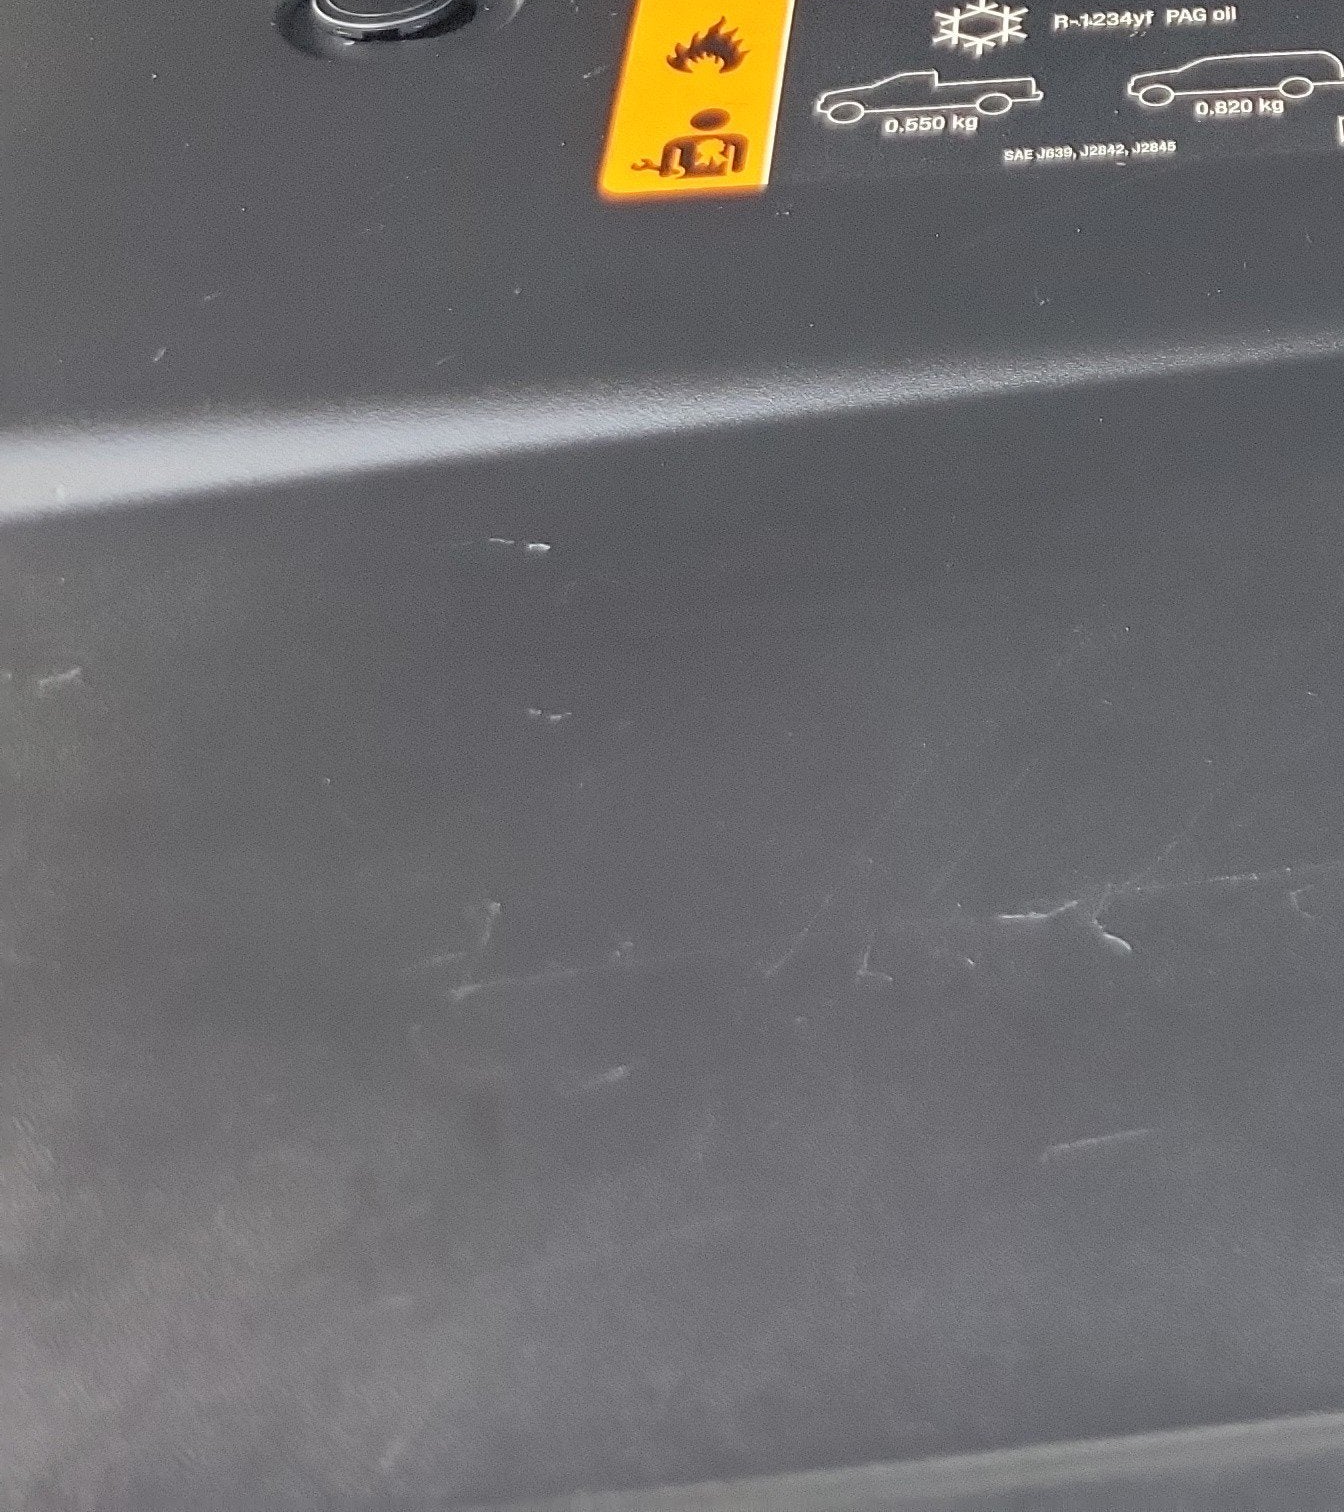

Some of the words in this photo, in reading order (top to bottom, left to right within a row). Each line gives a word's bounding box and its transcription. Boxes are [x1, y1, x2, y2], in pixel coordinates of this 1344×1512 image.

[1054, 10, 1154, 31] R-1234yf
[1166, 7, 1207, 25] PAG
[1212, 5, 1237, 21] oil
[1195, 98, 1253, 117] 0.820
[1259, 97, 1284, 115] kg
[884, 116, 946, 134] 0.550
[951, 113, 978, 133] kg
[1004, 148, 1034, 161] SAE
[1080, 143, 1129, 156] J2842,
[1132, 140, 1177, 154] J2845
